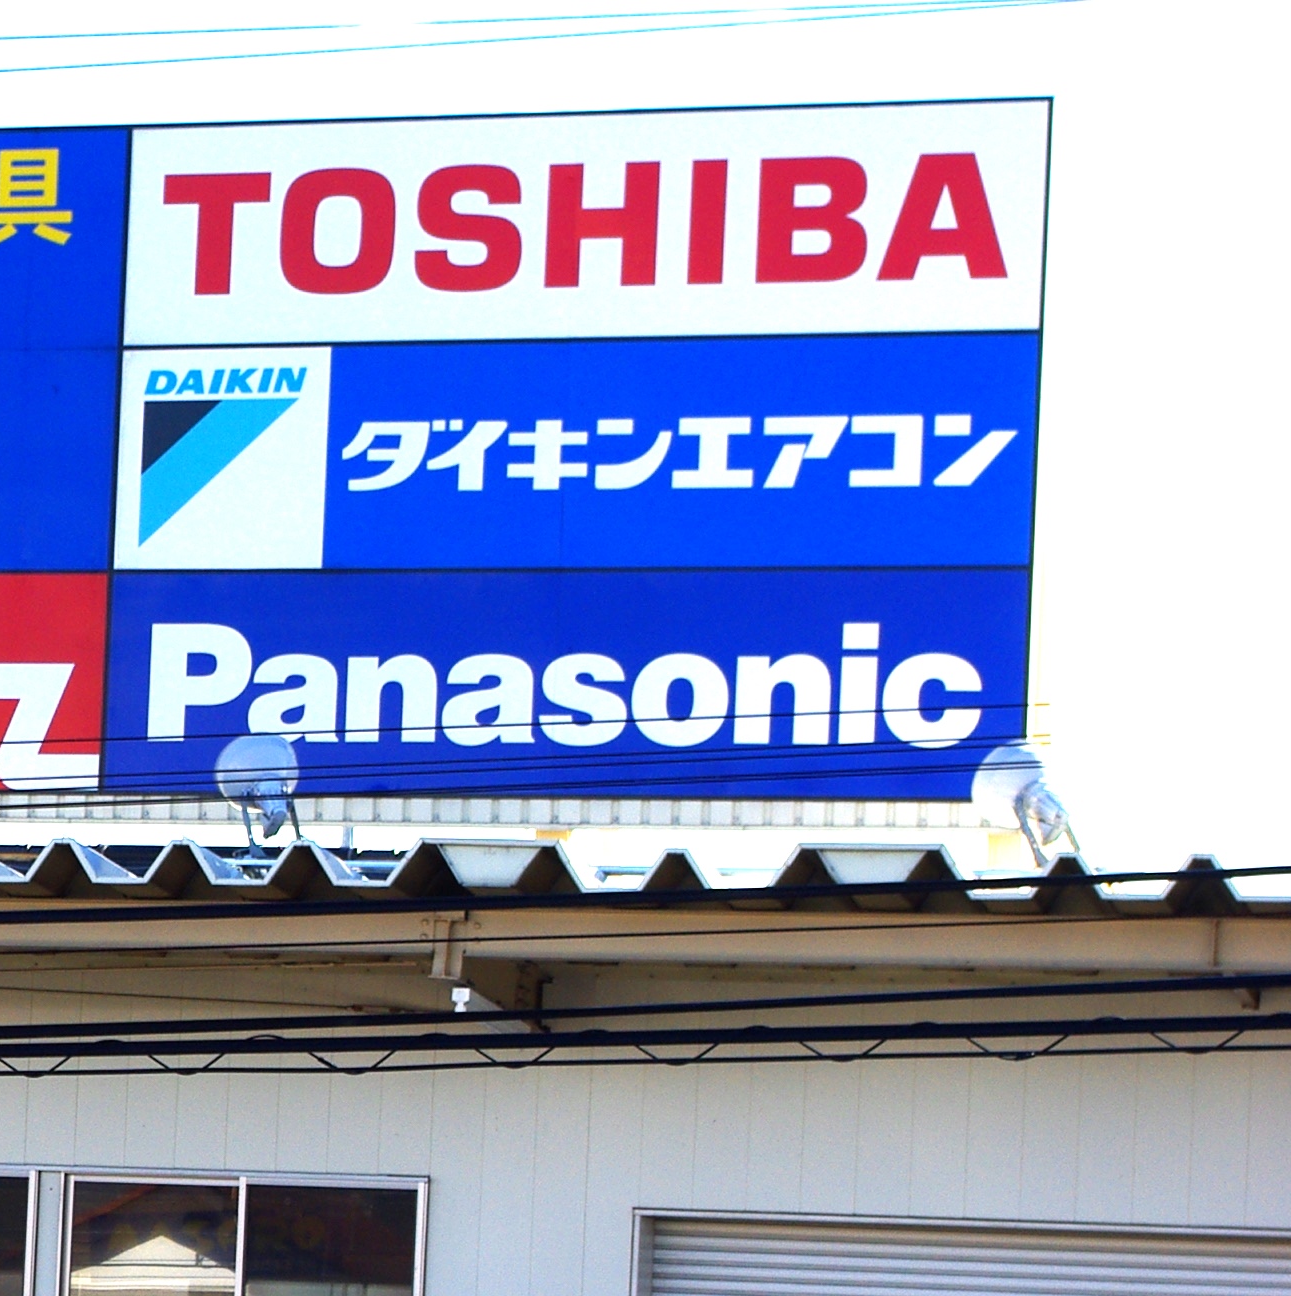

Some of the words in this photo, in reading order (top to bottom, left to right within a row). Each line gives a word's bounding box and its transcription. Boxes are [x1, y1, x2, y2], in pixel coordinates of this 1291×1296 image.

[162, 151, 1009, 297] TOSHIBA
[144, 366, 308, 396] DAIKIN
[342, 413, 1020, 493] ダイキンエアコン
[146, 622, 984, 749] Panasonic
